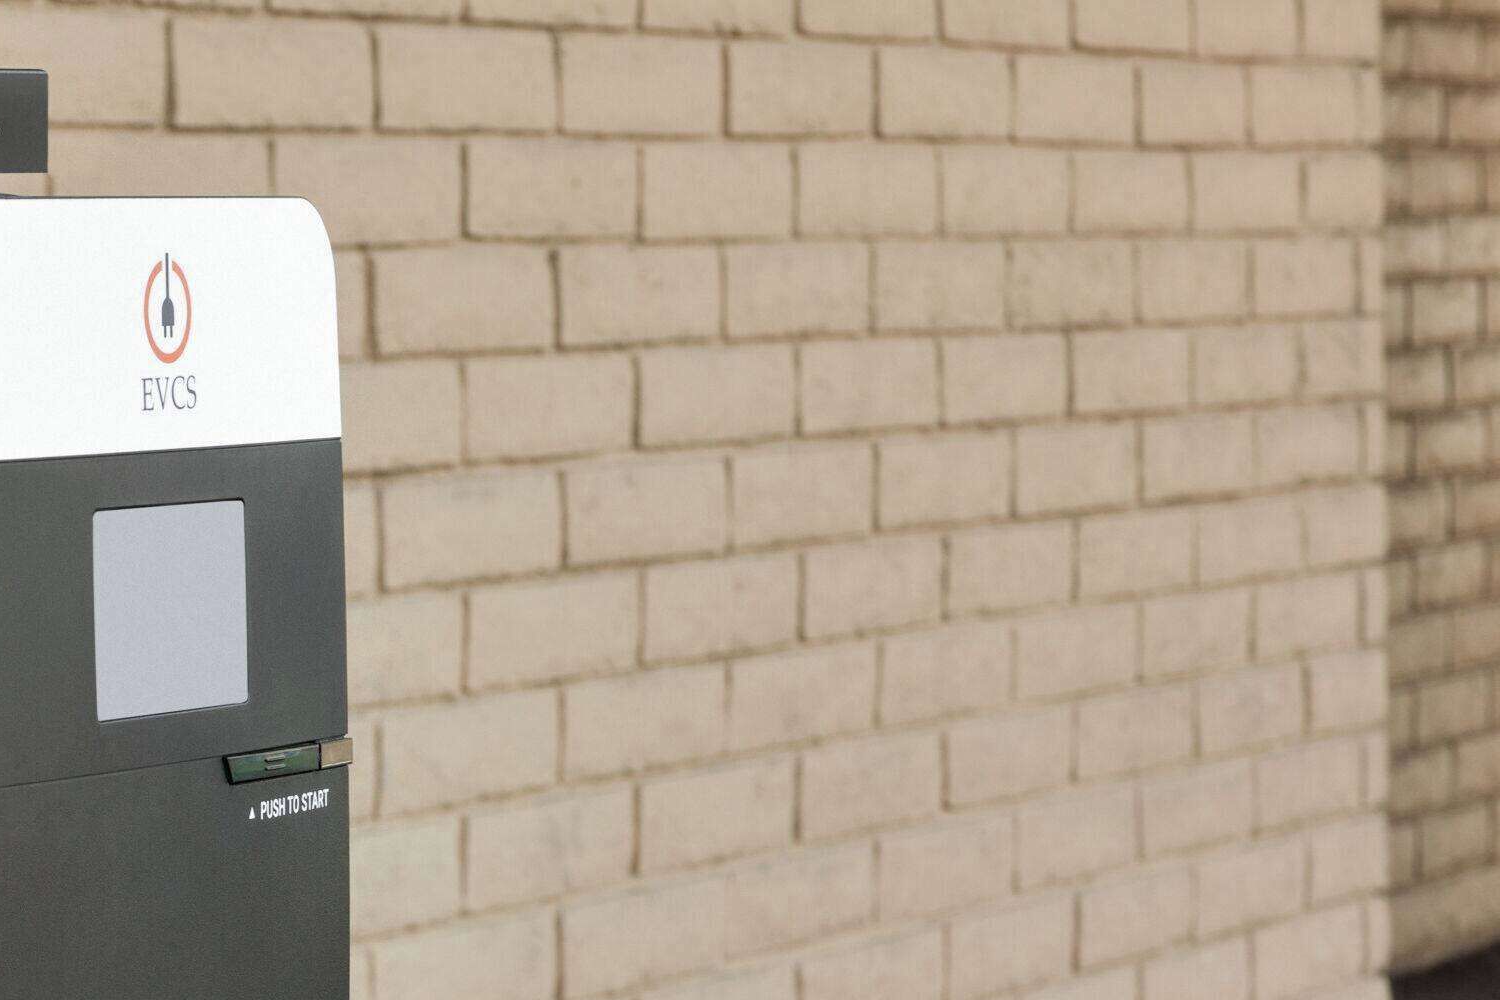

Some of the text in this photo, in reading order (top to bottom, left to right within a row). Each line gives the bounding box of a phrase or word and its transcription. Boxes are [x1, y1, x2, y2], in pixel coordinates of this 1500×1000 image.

[141, 375, 197, 411] EVCS
[260, 789, 329, 819] PUSH TO START
